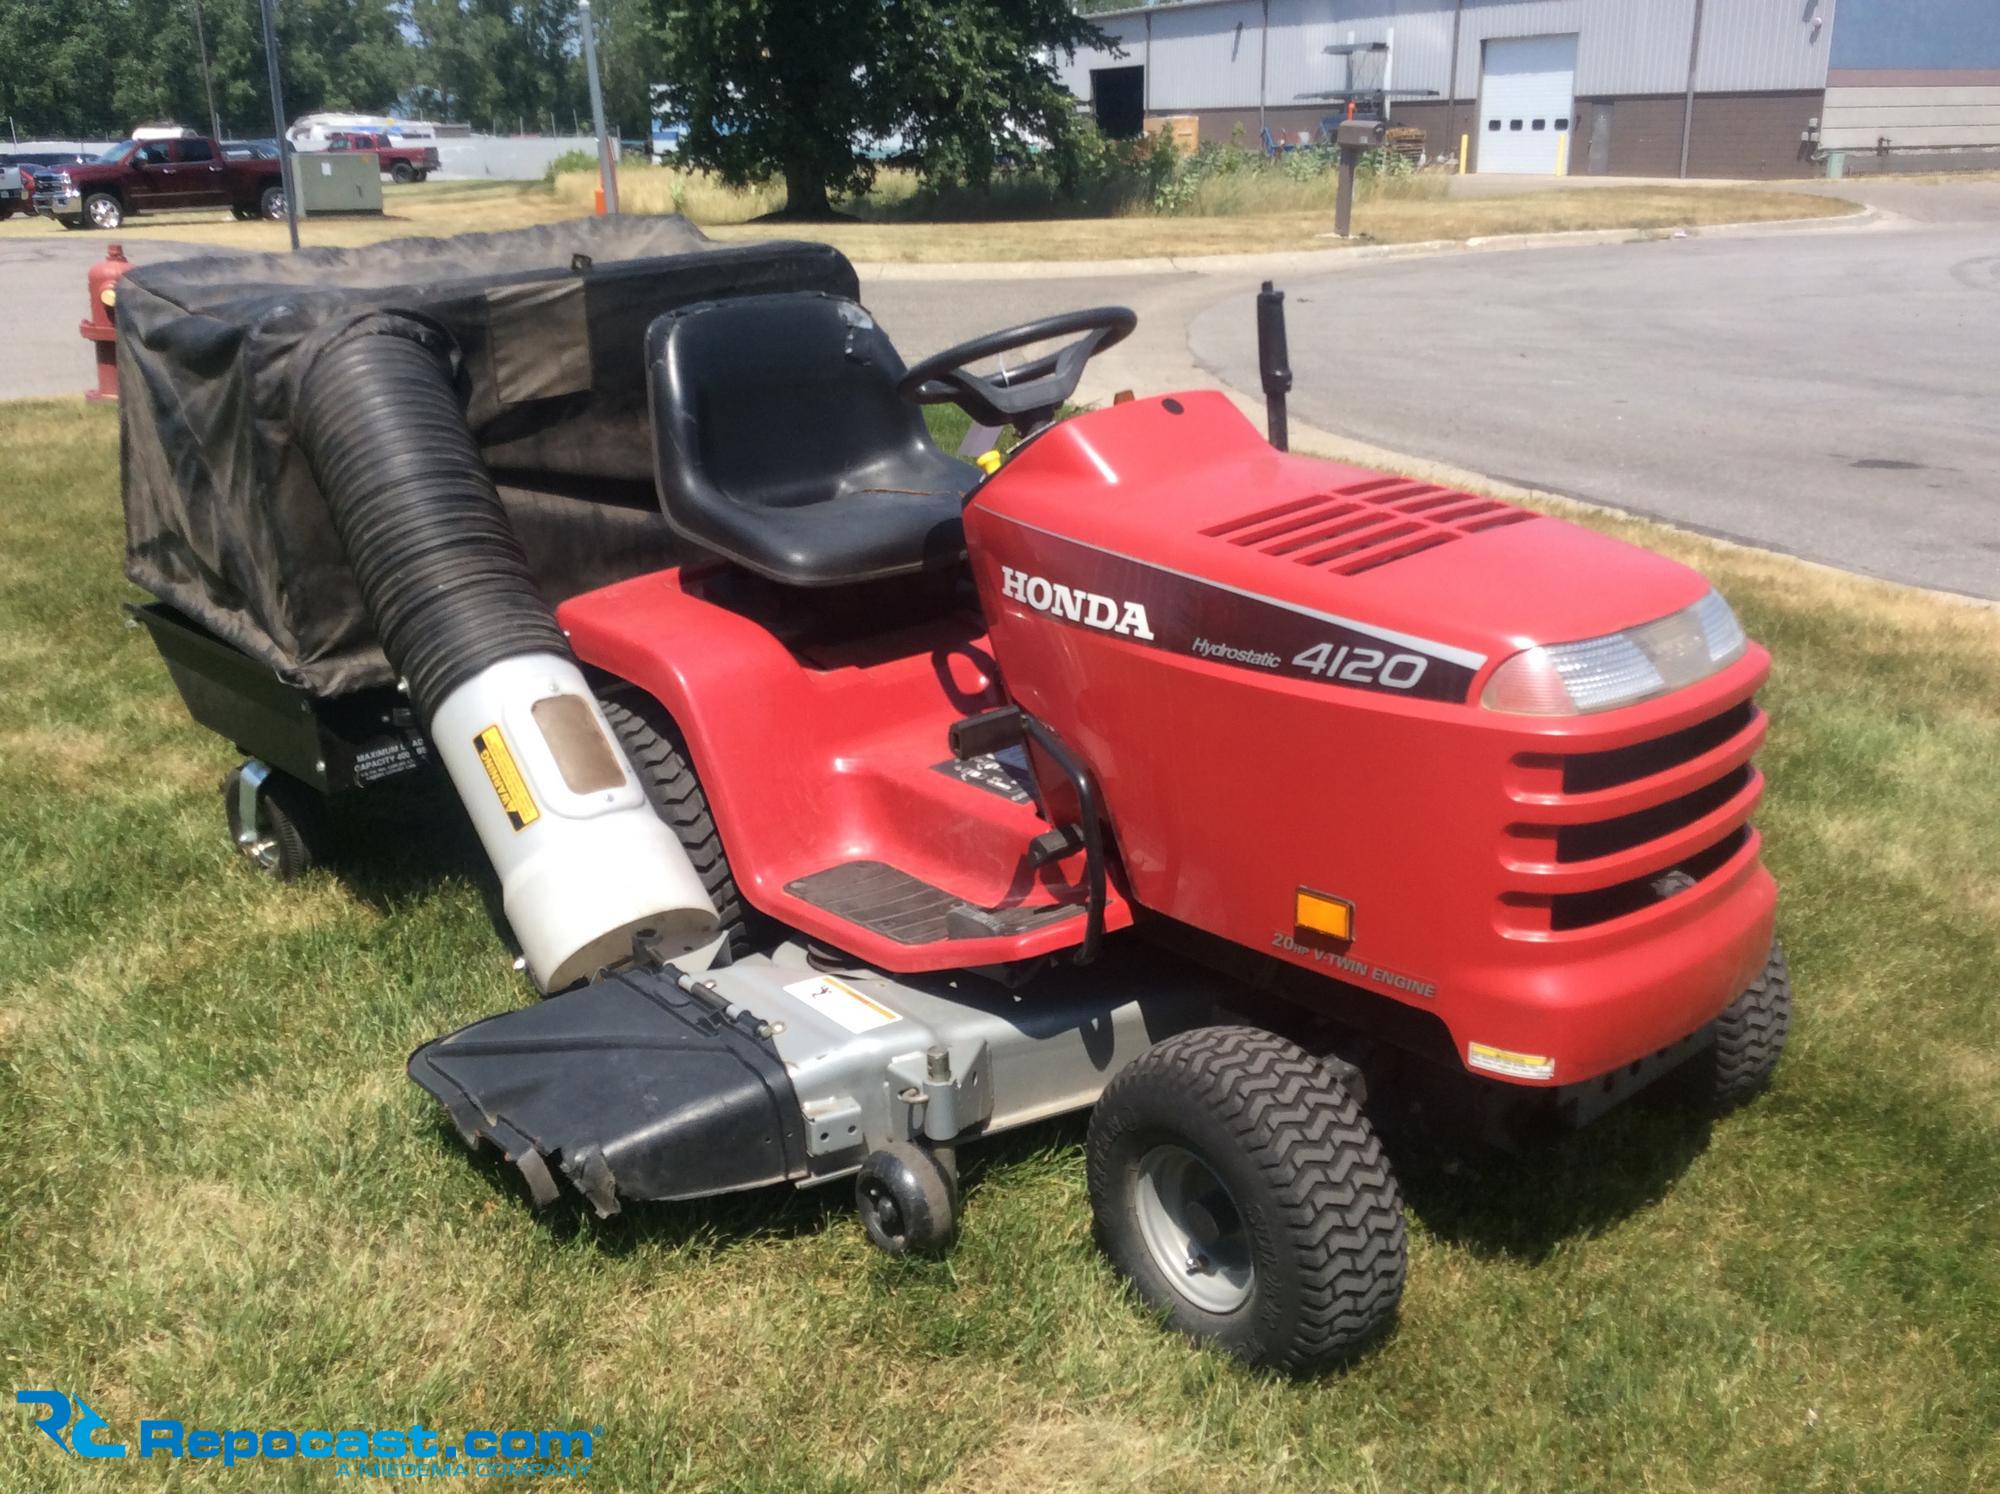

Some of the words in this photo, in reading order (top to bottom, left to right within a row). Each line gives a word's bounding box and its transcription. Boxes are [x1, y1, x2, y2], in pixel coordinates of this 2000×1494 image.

[1001, 565, 1154, 640] HONDA
[1191, 636, 1282, 670] Hydrostatic
[1291, 642, 1429, 690] 4120
[354, 755, 395, 773] CAPACITY
[356, 745, 399, 762] MAXIMUM
[480, 749, 515, 812] WARNING
[1372, 967, 1436, 998] ENGINE
